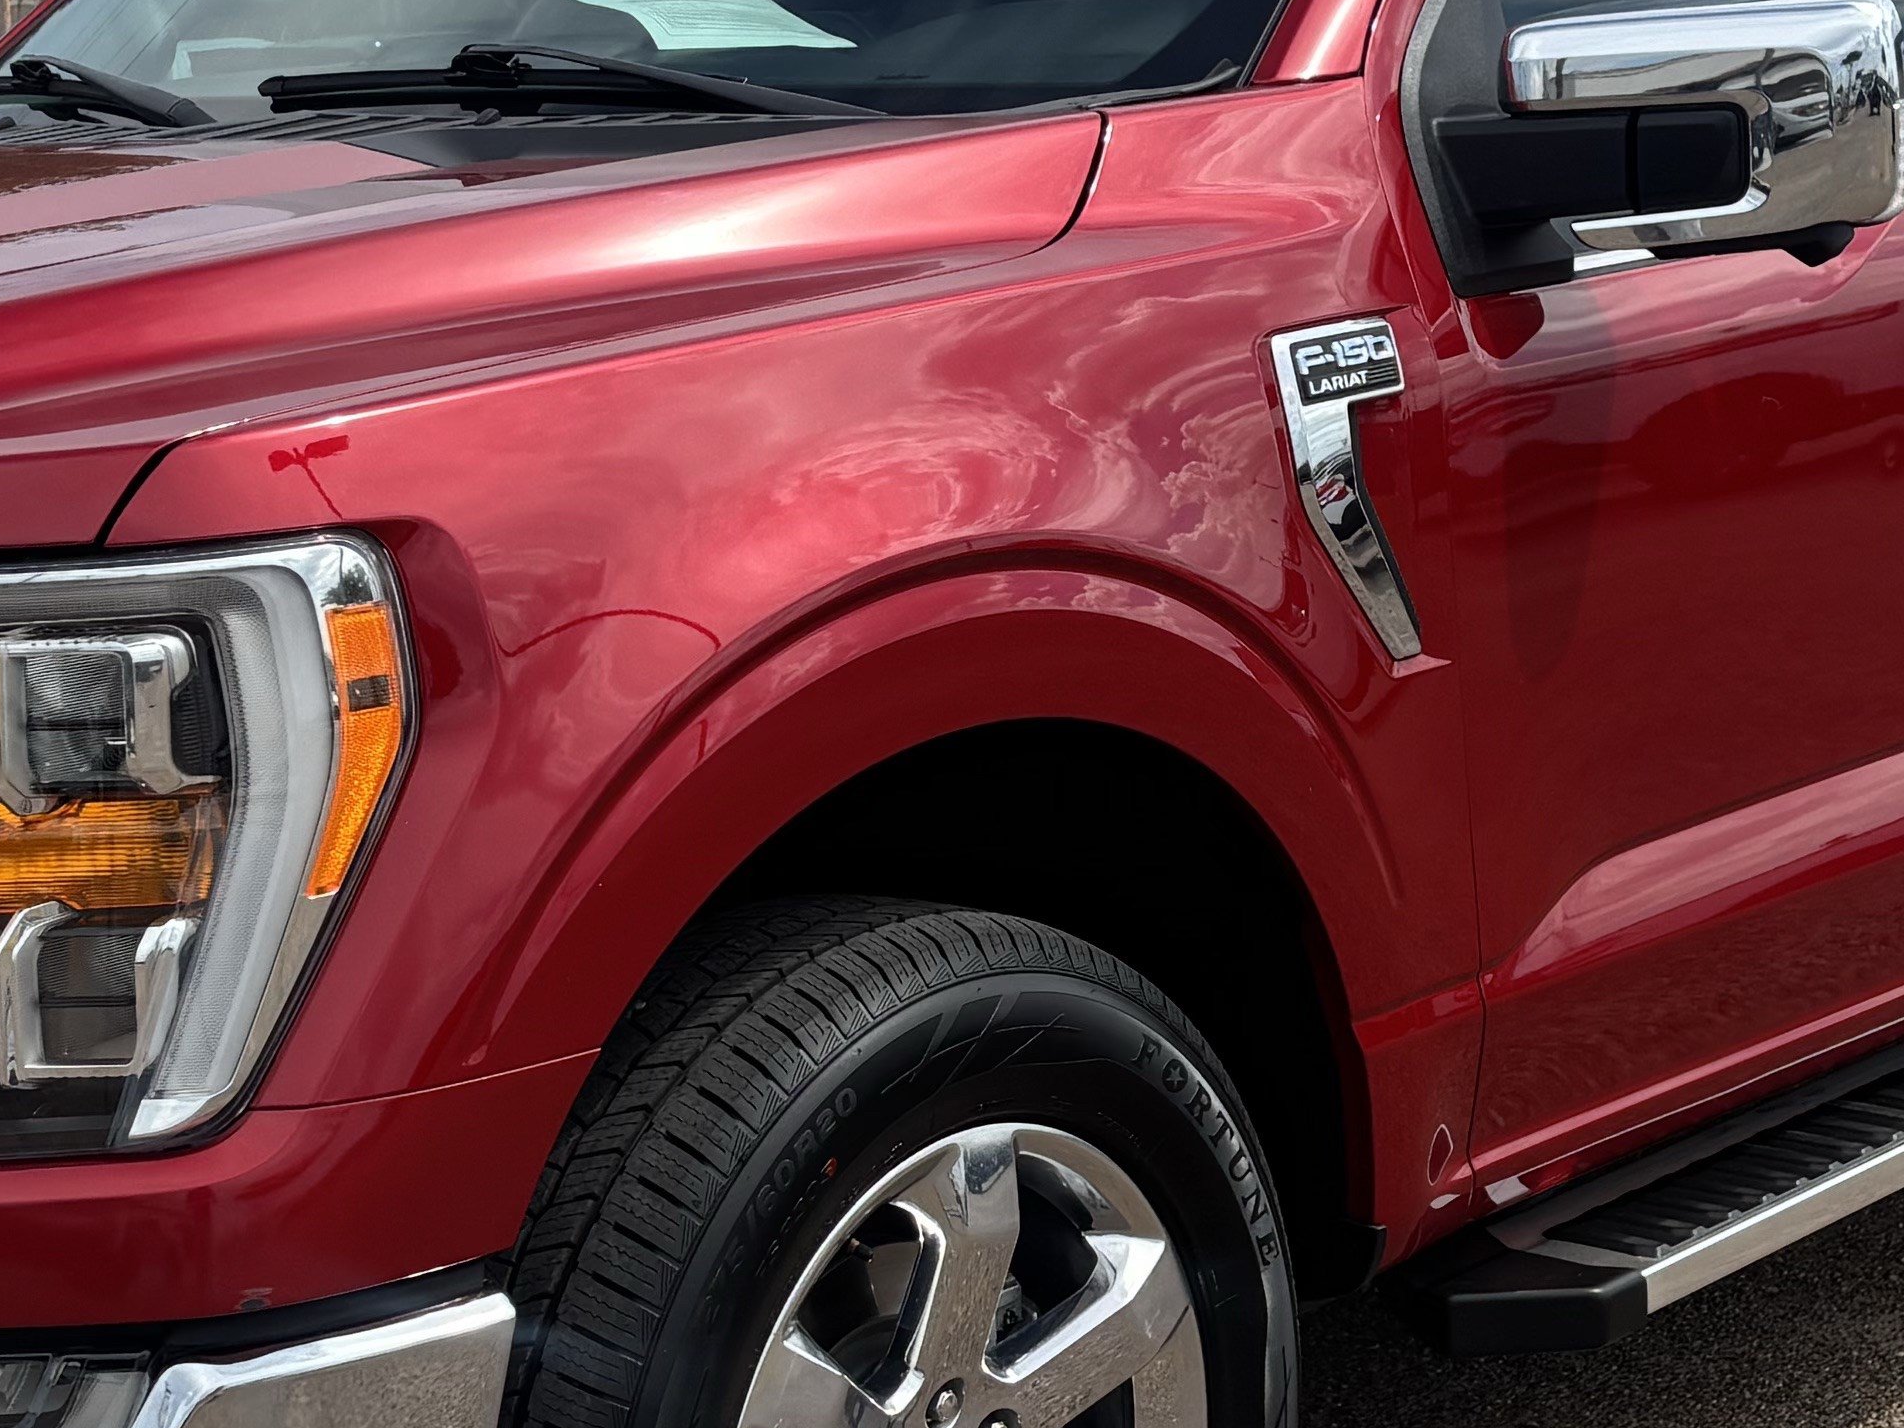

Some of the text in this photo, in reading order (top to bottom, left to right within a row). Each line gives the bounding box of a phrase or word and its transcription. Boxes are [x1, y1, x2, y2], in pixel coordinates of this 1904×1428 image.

[1295, 333, 1395, 375] F-150
[1308, 370, 1369, 396] LARIAT
[1127, 1033, 1282, 1267] FORTUNE
